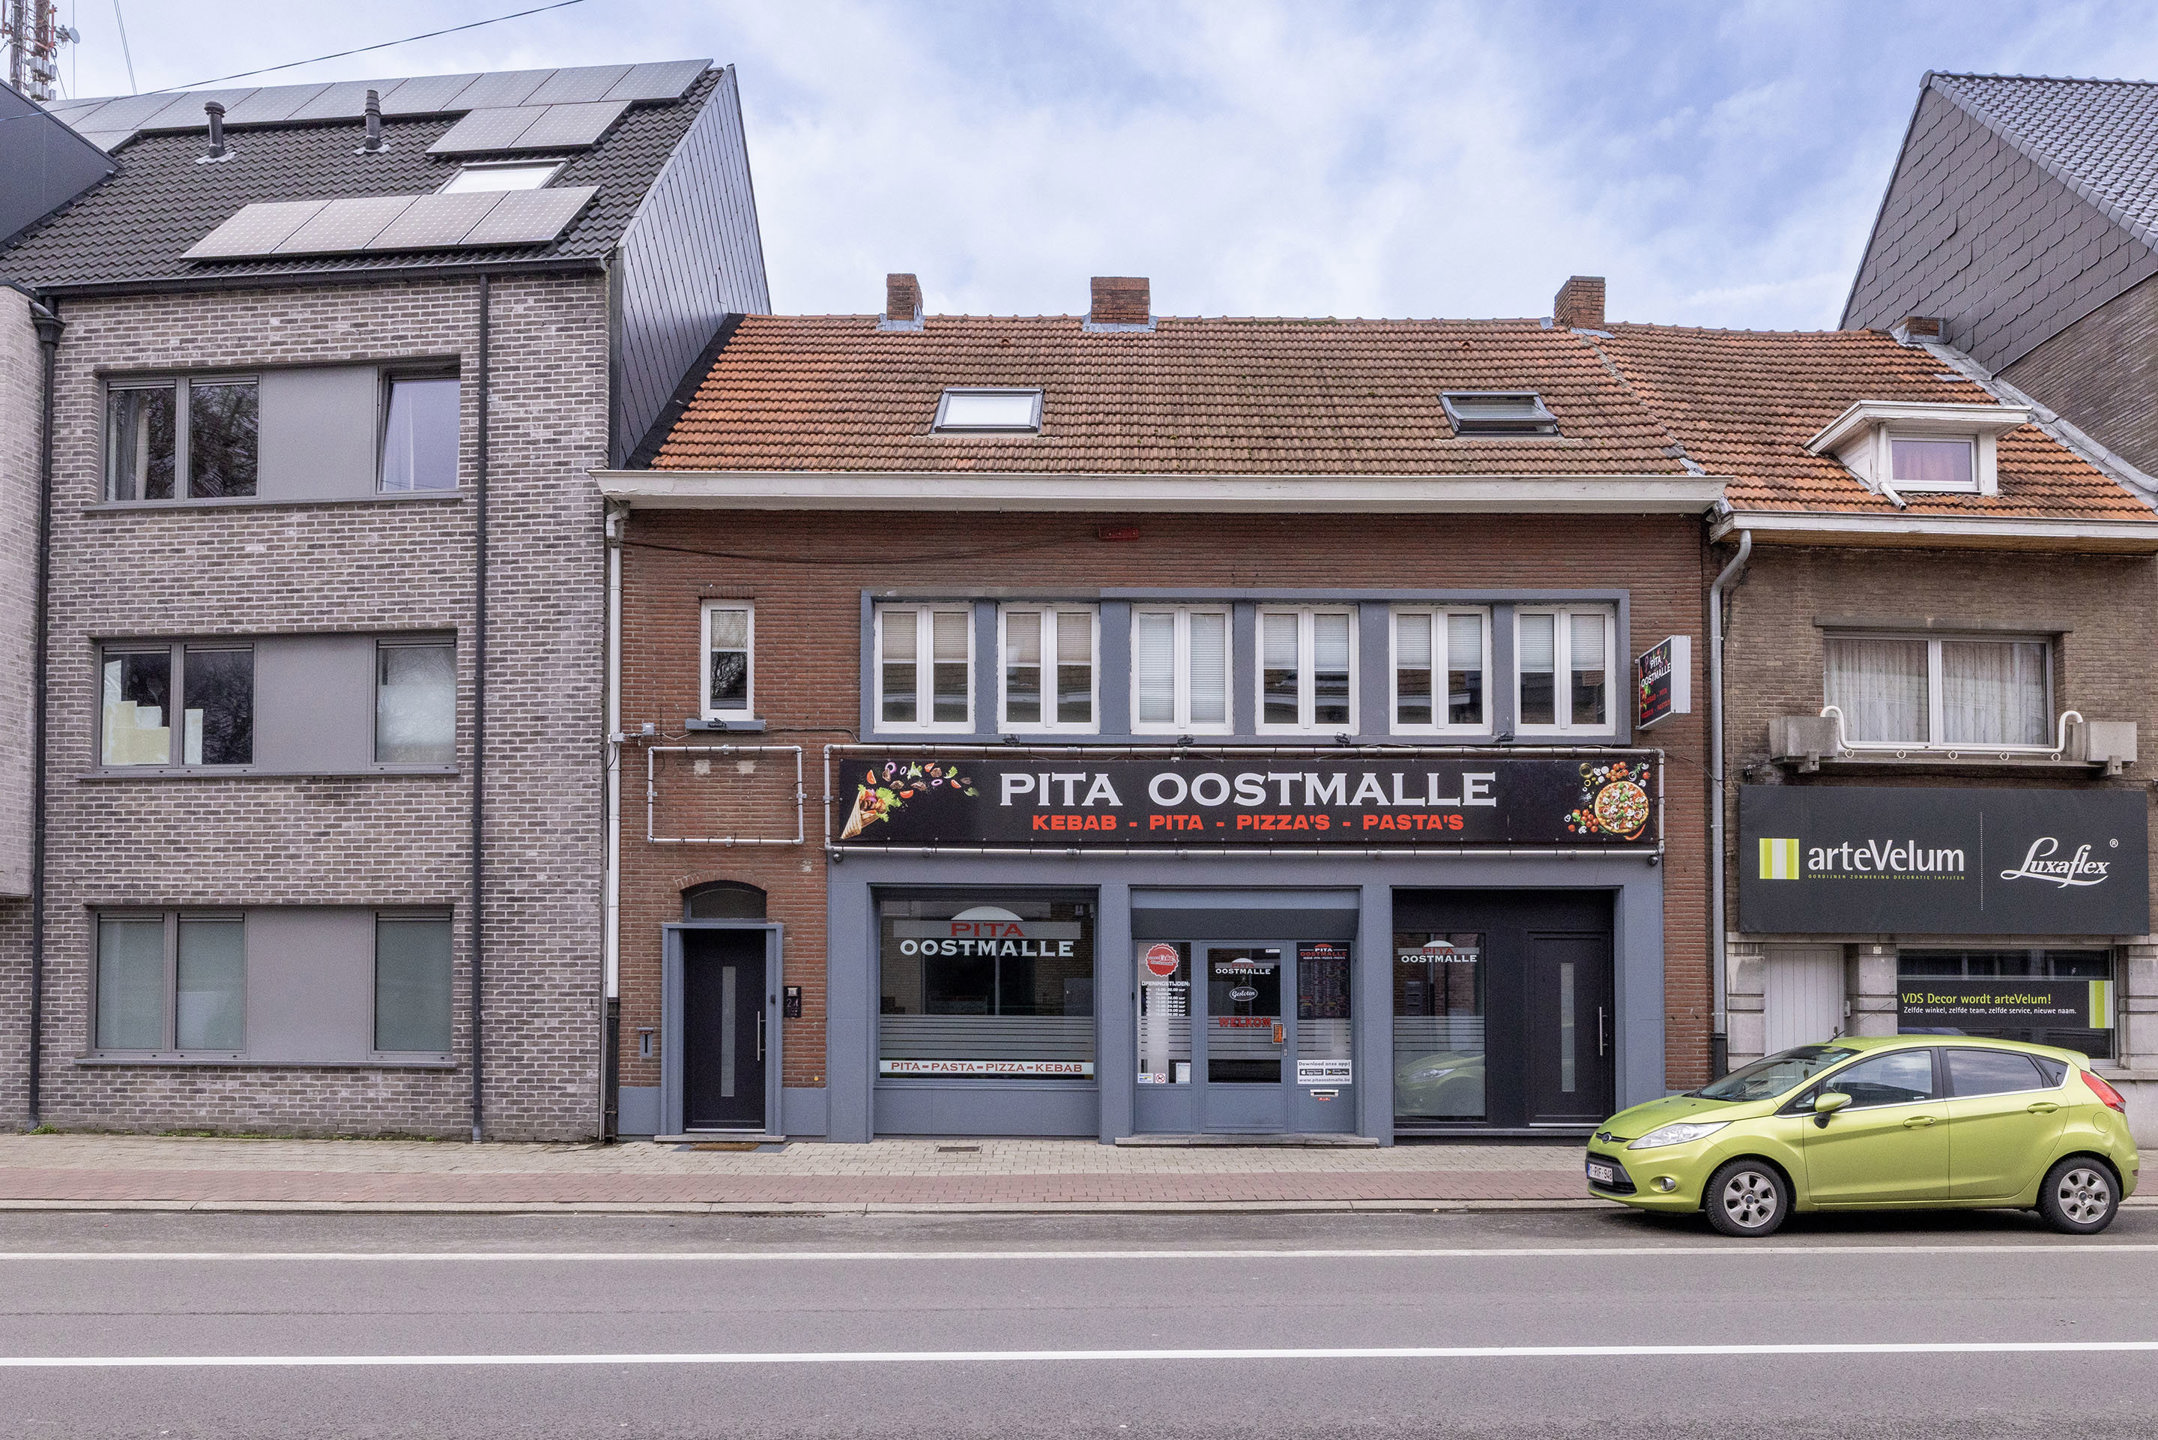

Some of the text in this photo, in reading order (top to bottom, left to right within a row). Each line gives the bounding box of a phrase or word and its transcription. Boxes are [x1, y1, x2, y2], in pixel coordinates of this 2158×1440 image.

[1649, 654, 1661, 669] PITA
[1641, 662, 1671, 688] OOSTMALLE
[999, 771, 1497, 808] PITA OOSTMALLE
[1032, 814, 1118, 831] KEBAB
[1149, 814, 1205, 831] PITA
[1236, 814, 1331, 831] PIZZA'S
[1362, 813, 1464, 831] PASTA'S
[1807, 839, 1965, 872] arteVelum
[1999, 836, 2111, 889] Luxaflex
[951, 922, 1025, 937] PITA
[899, 939, 1075, 957] OOSTMALLE
[1401, 954, 1478, 963] OOSTMALLE
[1232, 989, 1256, 998] Gesloten
[1902, 993, 2052, 1005] VDS Decor wordt arteVelum!
[1903, 1006, 1924, 1014] Zelfde
[1925, 1006, 1947, 1015] winkel,
[1949, 1006, 1968, 1014] zelfde
[1969, 1007, 1988, 1015] team,
[1988, 1006, 2008, 1015] zelfde
[2009, 1007, 2032, 1016] service,
[2033, 1007, 2056, 1015] nieuwe
[1218, 1015, 1272, 1028] WELKOM
